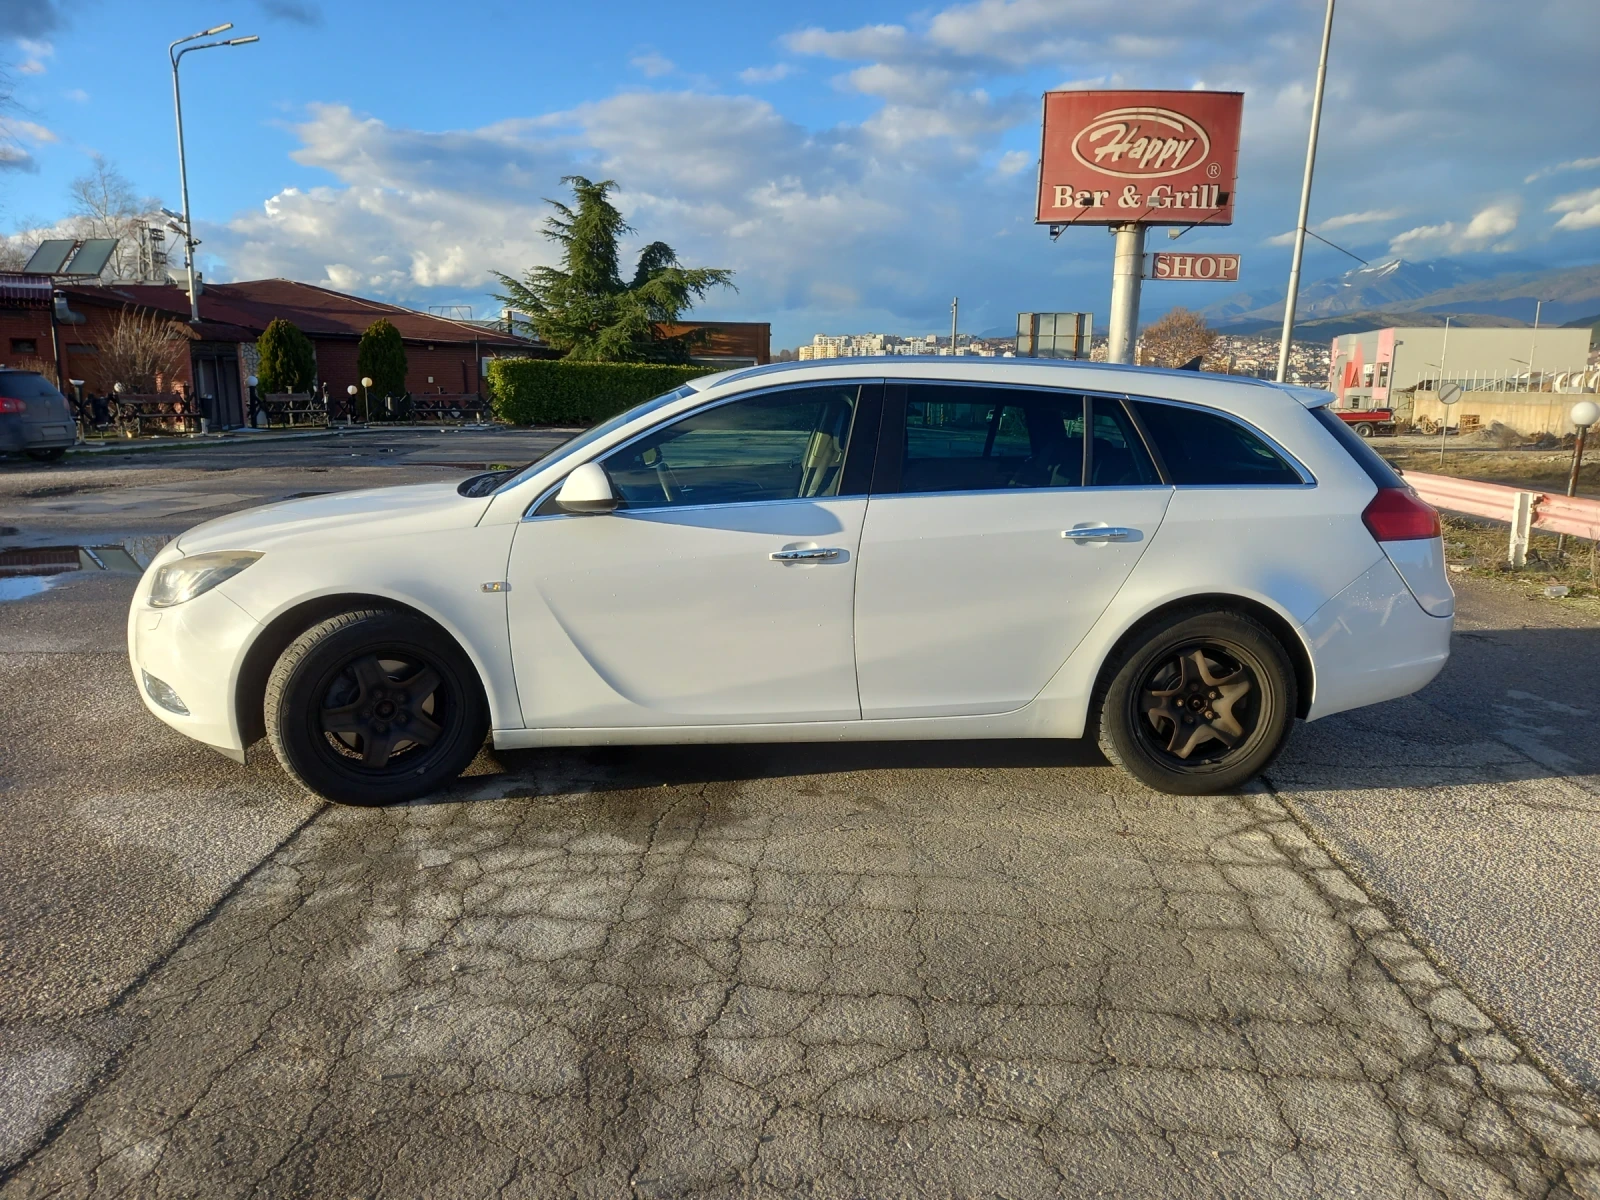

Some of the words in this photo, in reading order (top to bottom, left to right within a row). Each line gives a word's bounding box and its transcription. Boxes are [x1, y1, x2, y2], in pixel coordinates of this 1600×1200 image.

[1089, 122, 1196, 169] Happy
[1051, 184, 1110, 209] Bar
[1117, 183, 1144, 209] &
[1147, 184, 1221, 210] Grill
[1155, 255, 1239, 279] SHOP
